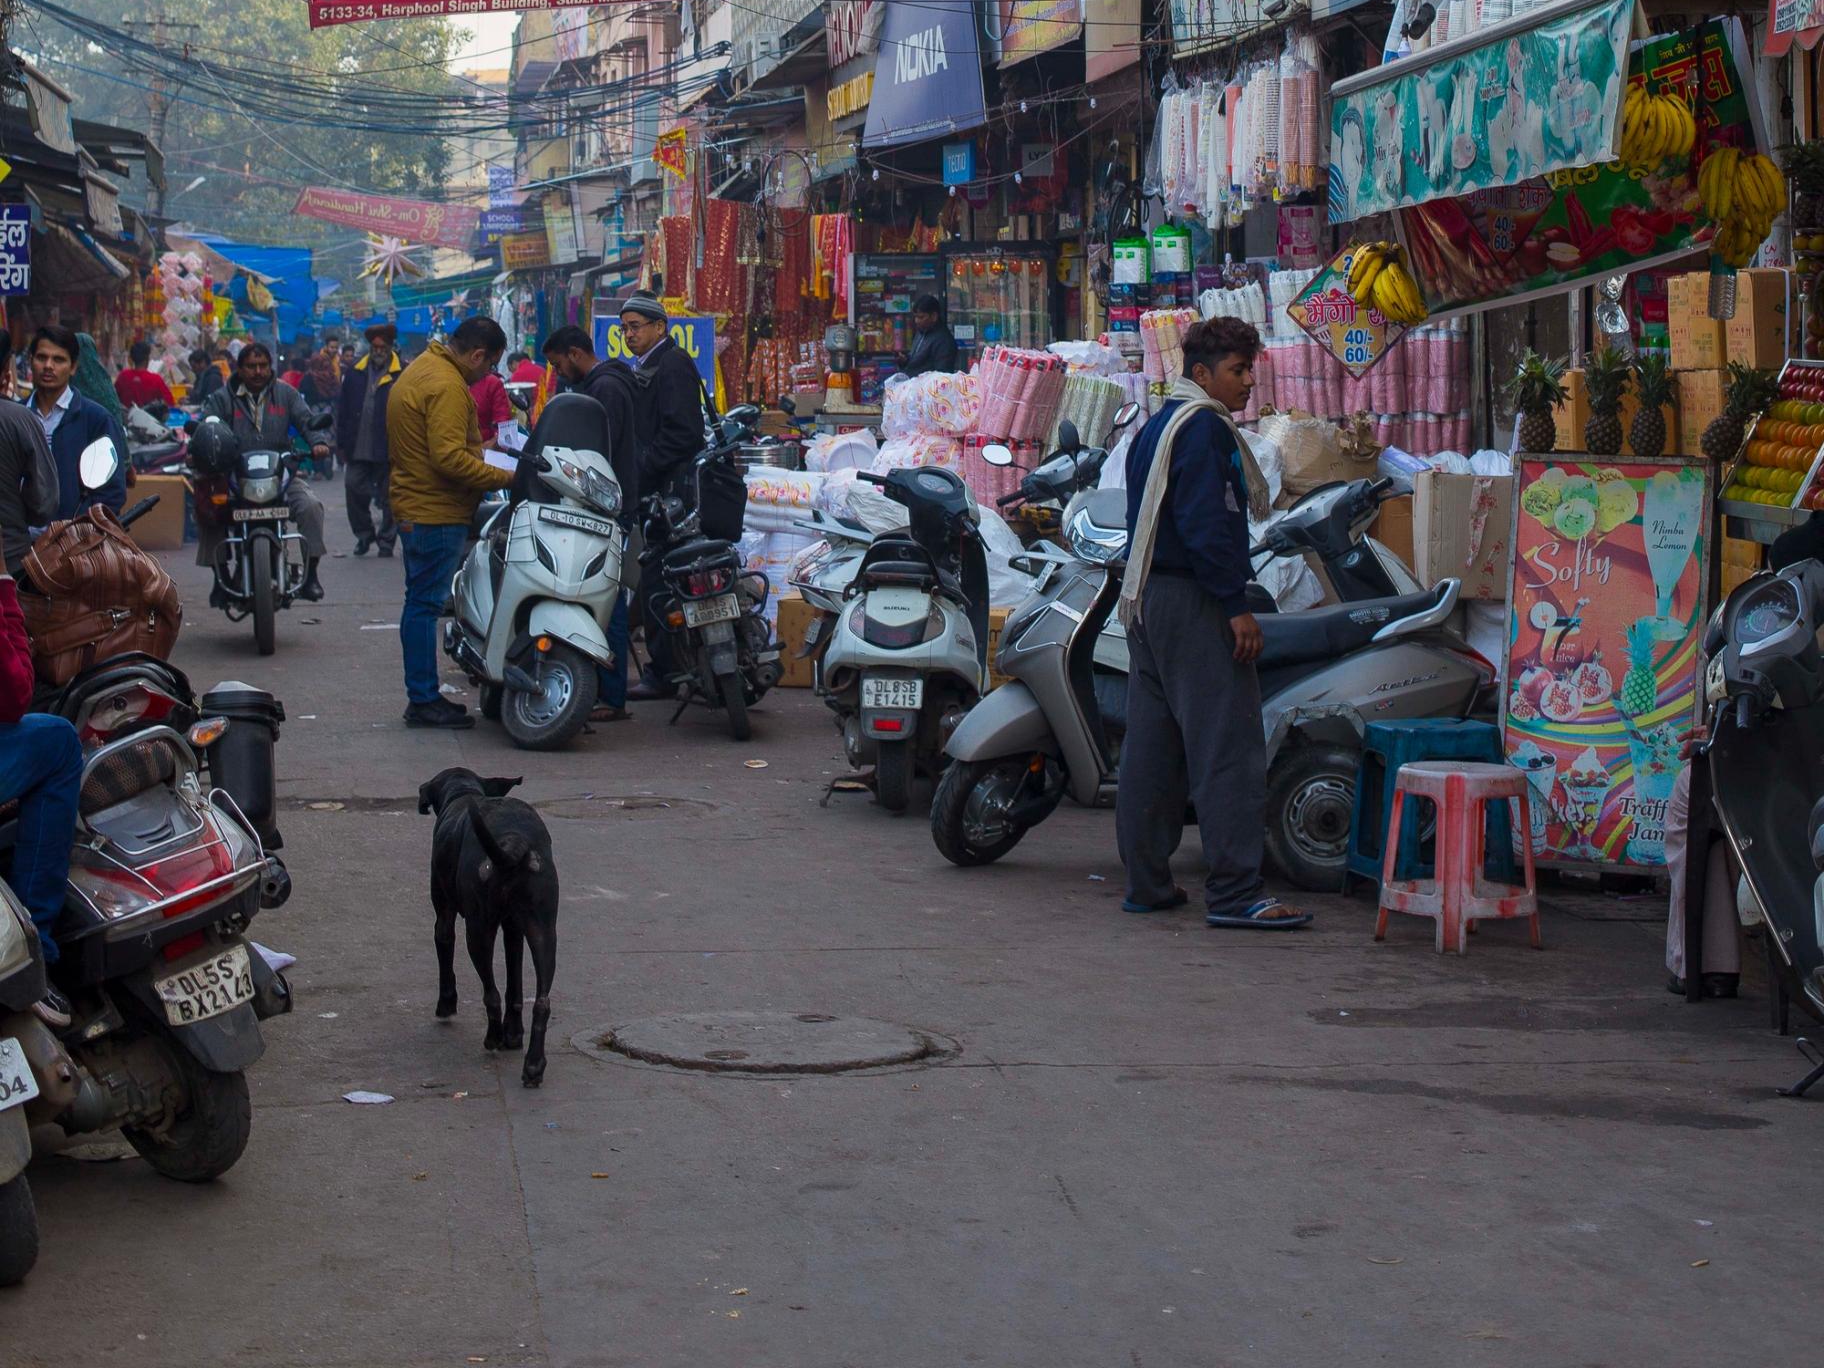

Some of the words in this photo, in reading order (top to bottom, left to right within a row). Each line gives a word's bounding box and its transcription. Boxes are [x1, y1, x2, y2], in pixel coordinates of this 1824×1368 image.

[319, 5, 378, 21] 5133-34,
[381, 1, 444, 17] Harphool
[894, 24, 949, 86] NOKIA
[948, 151, 966, 173] TECNO
[1306, 292, 1356, 327] मैंगो
[607, 324, 700, 359] SCOL
[1344, 329, 1374, 345] 40/-
[1344, 347, 1374, 364] 60/-
[1652, 538, 1688, 551] Lemon
[1525, 536, 1612, 592] Softy
[874, 681, 917, 694] DL8SB
[874, 694, 917, 707] E1415
[1619, 795, 1670, 822] Traff
[178, 958, 234, 996] DL5S
[179, 973, 253, 1022] BX2143
